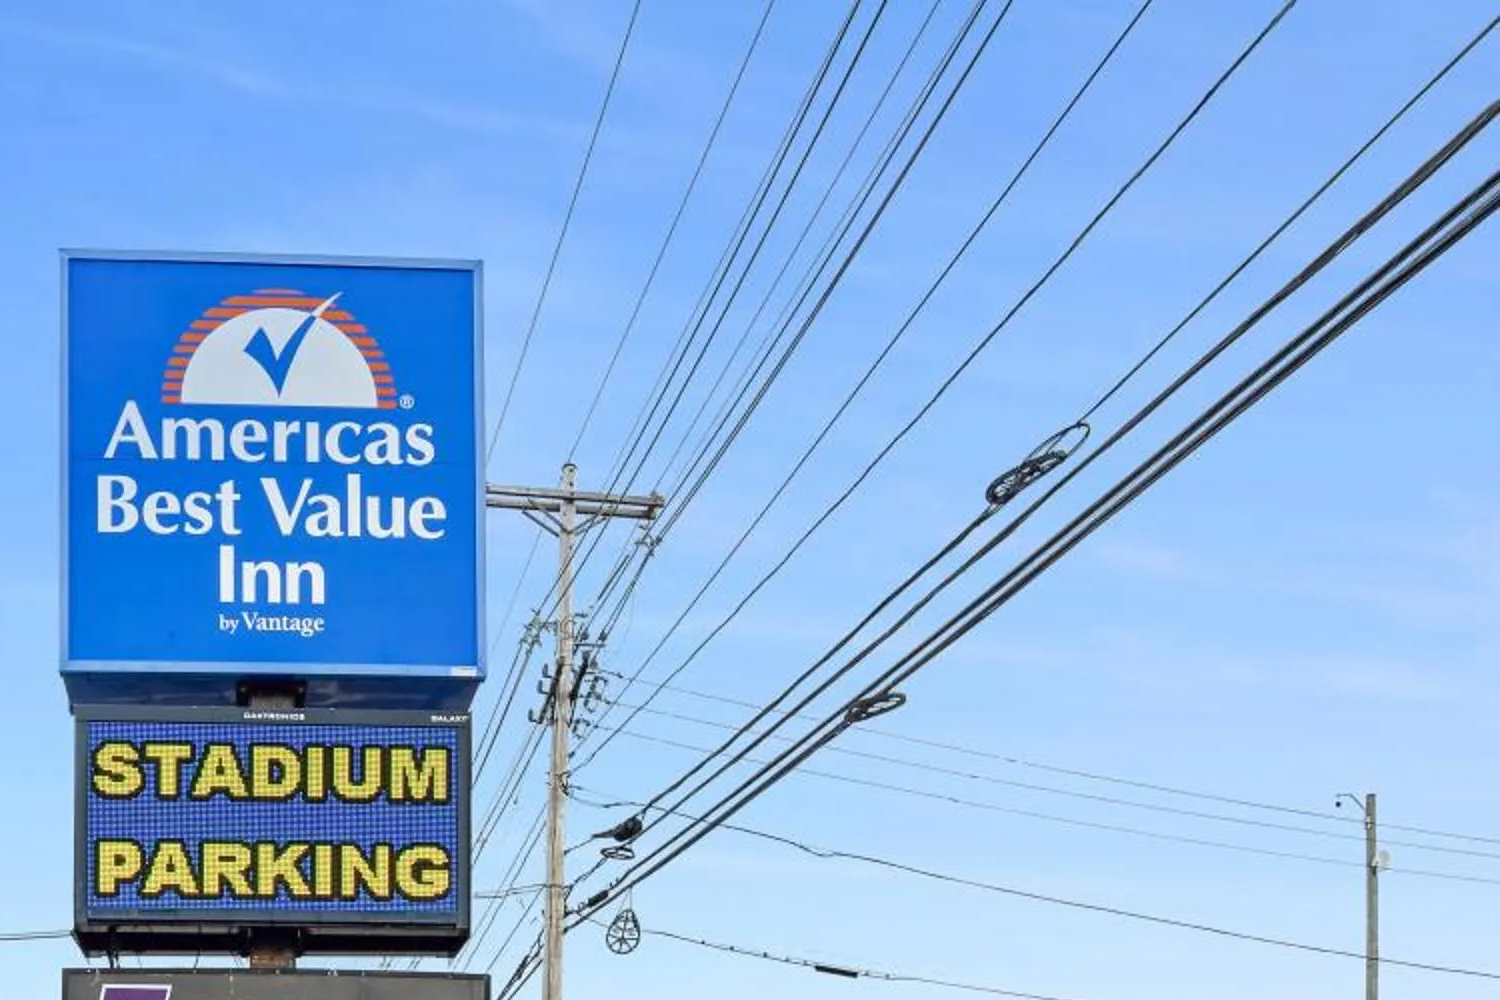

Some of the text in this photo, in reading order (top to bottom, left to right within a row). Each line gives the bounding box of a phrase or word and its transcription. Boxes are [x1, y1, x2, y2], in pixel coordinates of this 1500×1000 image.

[104, 400, 435, 466] Americas
[97, 474, 446, 538] Best Value
[219, 545, 325, 604] Inn
[218, 611, 325, 637] by Vantage
[94, 743, 448, 799] STADIUM
[99, 841, 449, 897] PARKING
